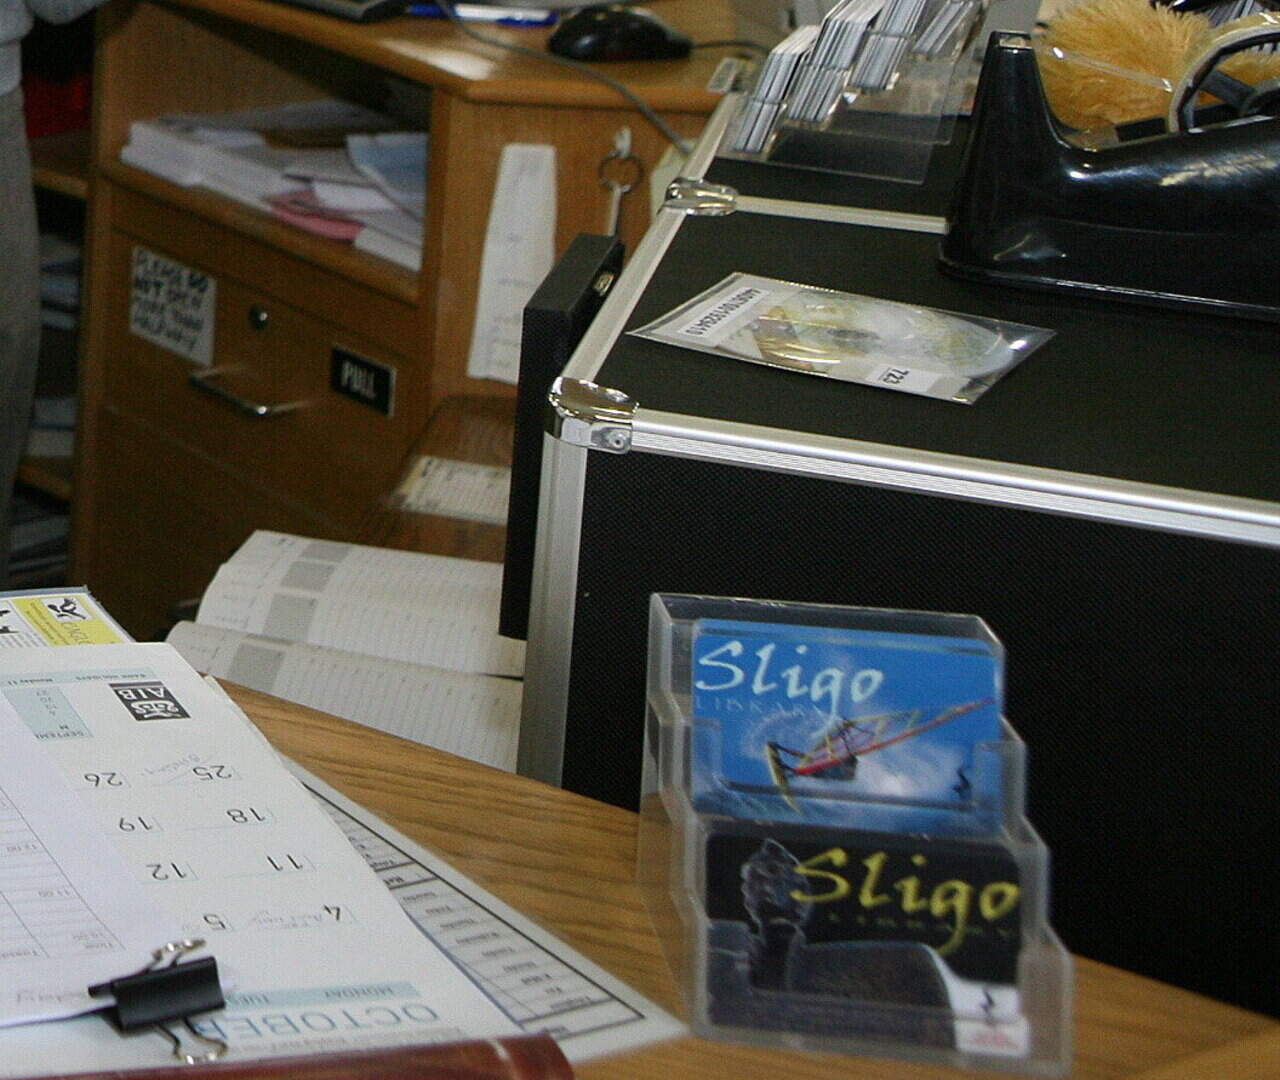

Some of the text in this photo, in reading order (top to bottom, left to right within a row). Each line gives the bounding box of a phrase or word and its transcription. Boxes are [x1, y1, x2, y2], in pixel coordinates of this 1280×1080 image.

[341, 360, 375, 400] PULL
[694, 638, 885, 724] Sligo
[117, 687, 166, 701] AIB
[84, 772, 123, 788] 26
[192, 764, 232, 781] 25
[118, 816, 153, 832] 19
[226, 807, 266, 824] 18
[266, 854, 305, 871] 11
[145, 862, 187, 881] 12
[790, 846, 1021, 957] Sligo
[203, 913, 227, 930] 5
[320, 903, 343, 923] 4
[324, 984, 395, 1000] MONDAY
[190, 1002, 440, 1040] OCTOBER
